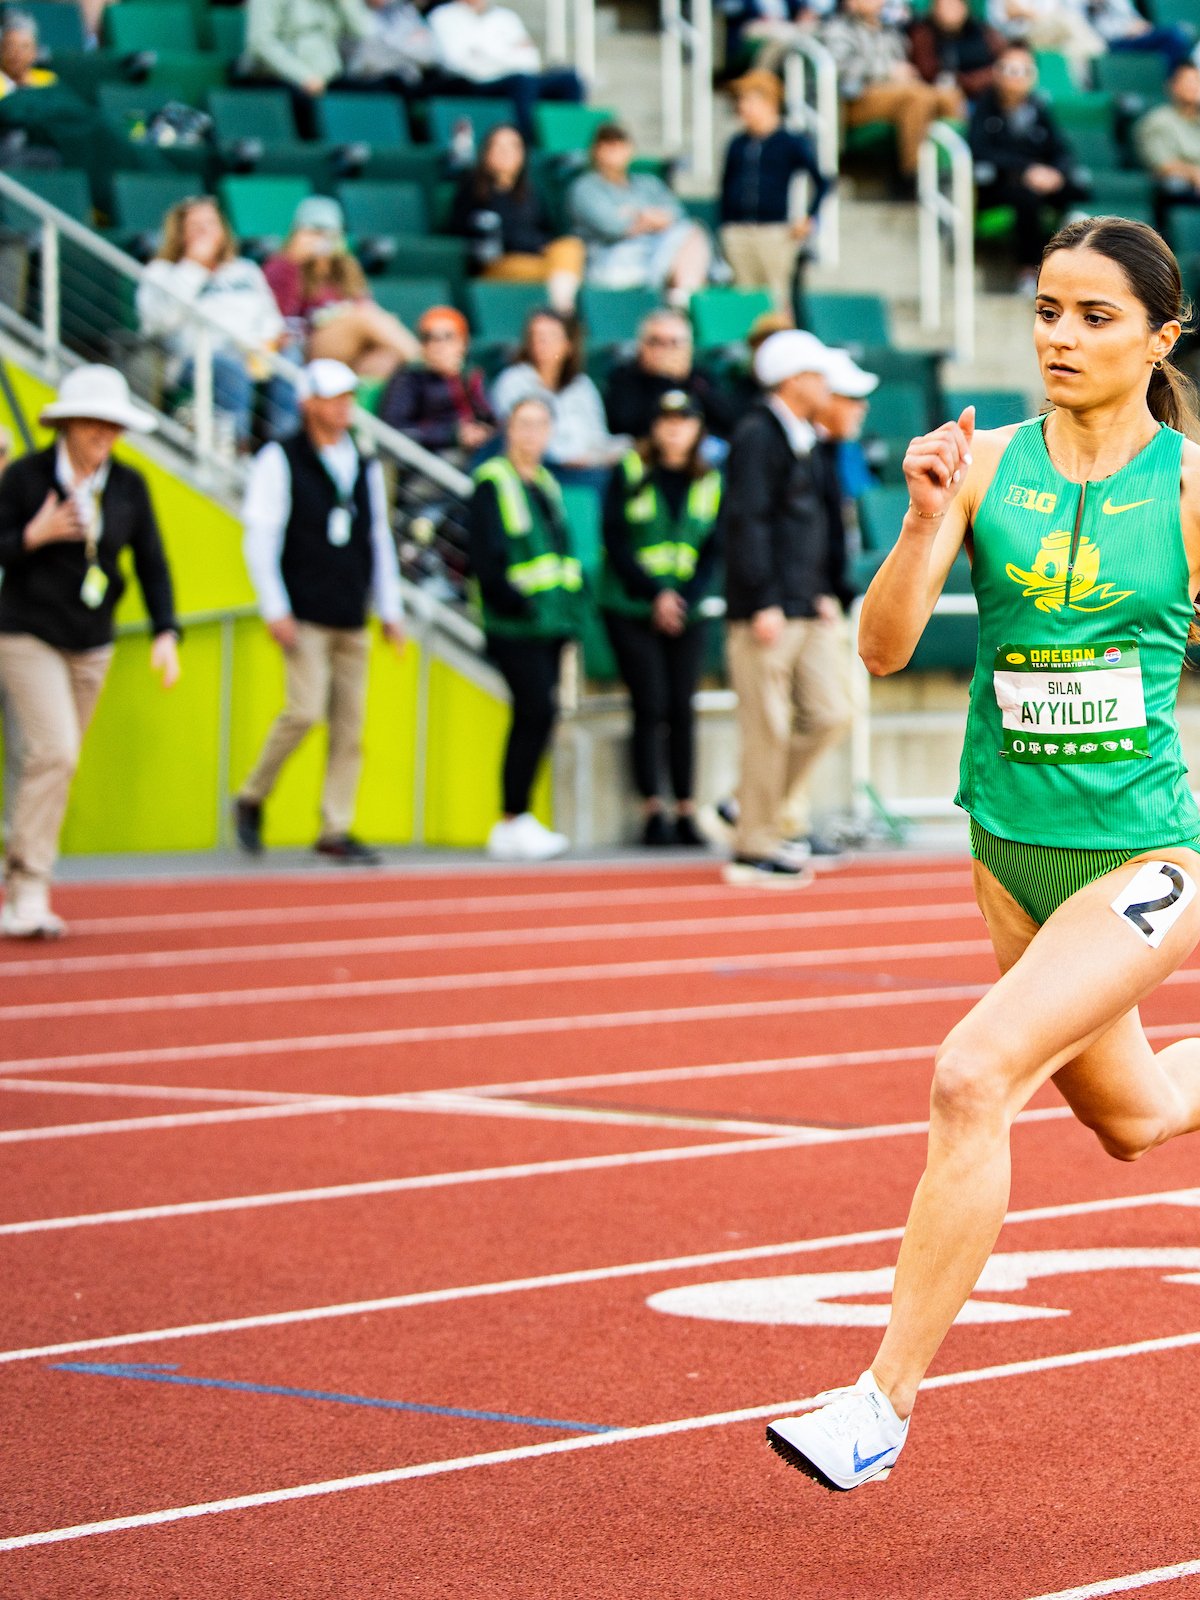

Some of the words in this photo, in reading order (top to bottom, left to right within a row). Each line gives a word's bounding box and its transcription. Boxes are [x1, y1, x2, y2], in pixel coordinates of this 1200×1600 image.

[1030, 648, 1095, 663] OREGON
[1050, 660, 1095, 668] INVITATIONAL
[1048, 681, 1082, 695] SILAN
[1021, 698, 1118, 725] AYYILDIZ
[1123, 865, 1184, 938] 2
